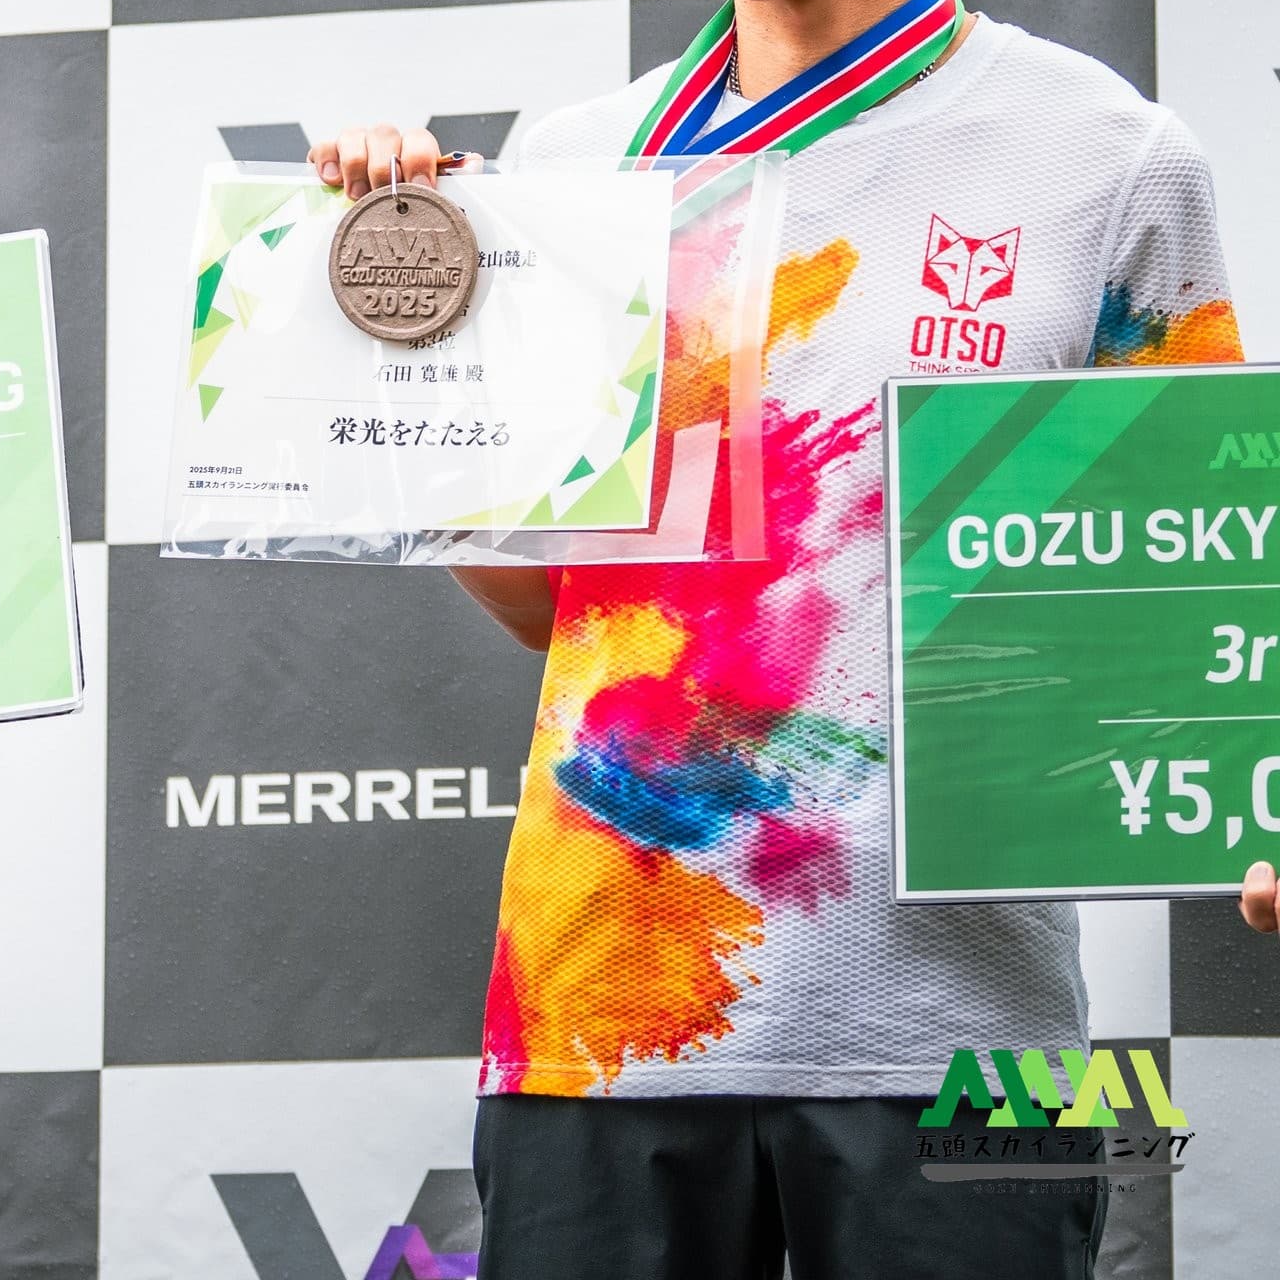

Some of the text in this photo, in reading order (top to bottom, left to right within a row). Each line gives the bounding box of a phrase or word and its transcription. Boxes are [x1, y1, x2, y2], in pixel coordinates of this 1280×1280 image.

[341, 268, 461, 288] GOZU SKYRUNNING
[363, 288, 437, 318] 2025
[910, 315, 1006, 368] OTSO
[464, 364, 485, 383] 殿
[910, 361, 952, 374] THINK
[328, 416, 513, 447] 栄光をたたえる
[189, 466, 243, 475] 2025年9月21日
[946, 511, 1124, 570] GOZU
[1204, 624, 1279, 685] 3r
[165, 765, 527, 829] MERREL
[1109, 755, 1280, 850] ¥5,0
